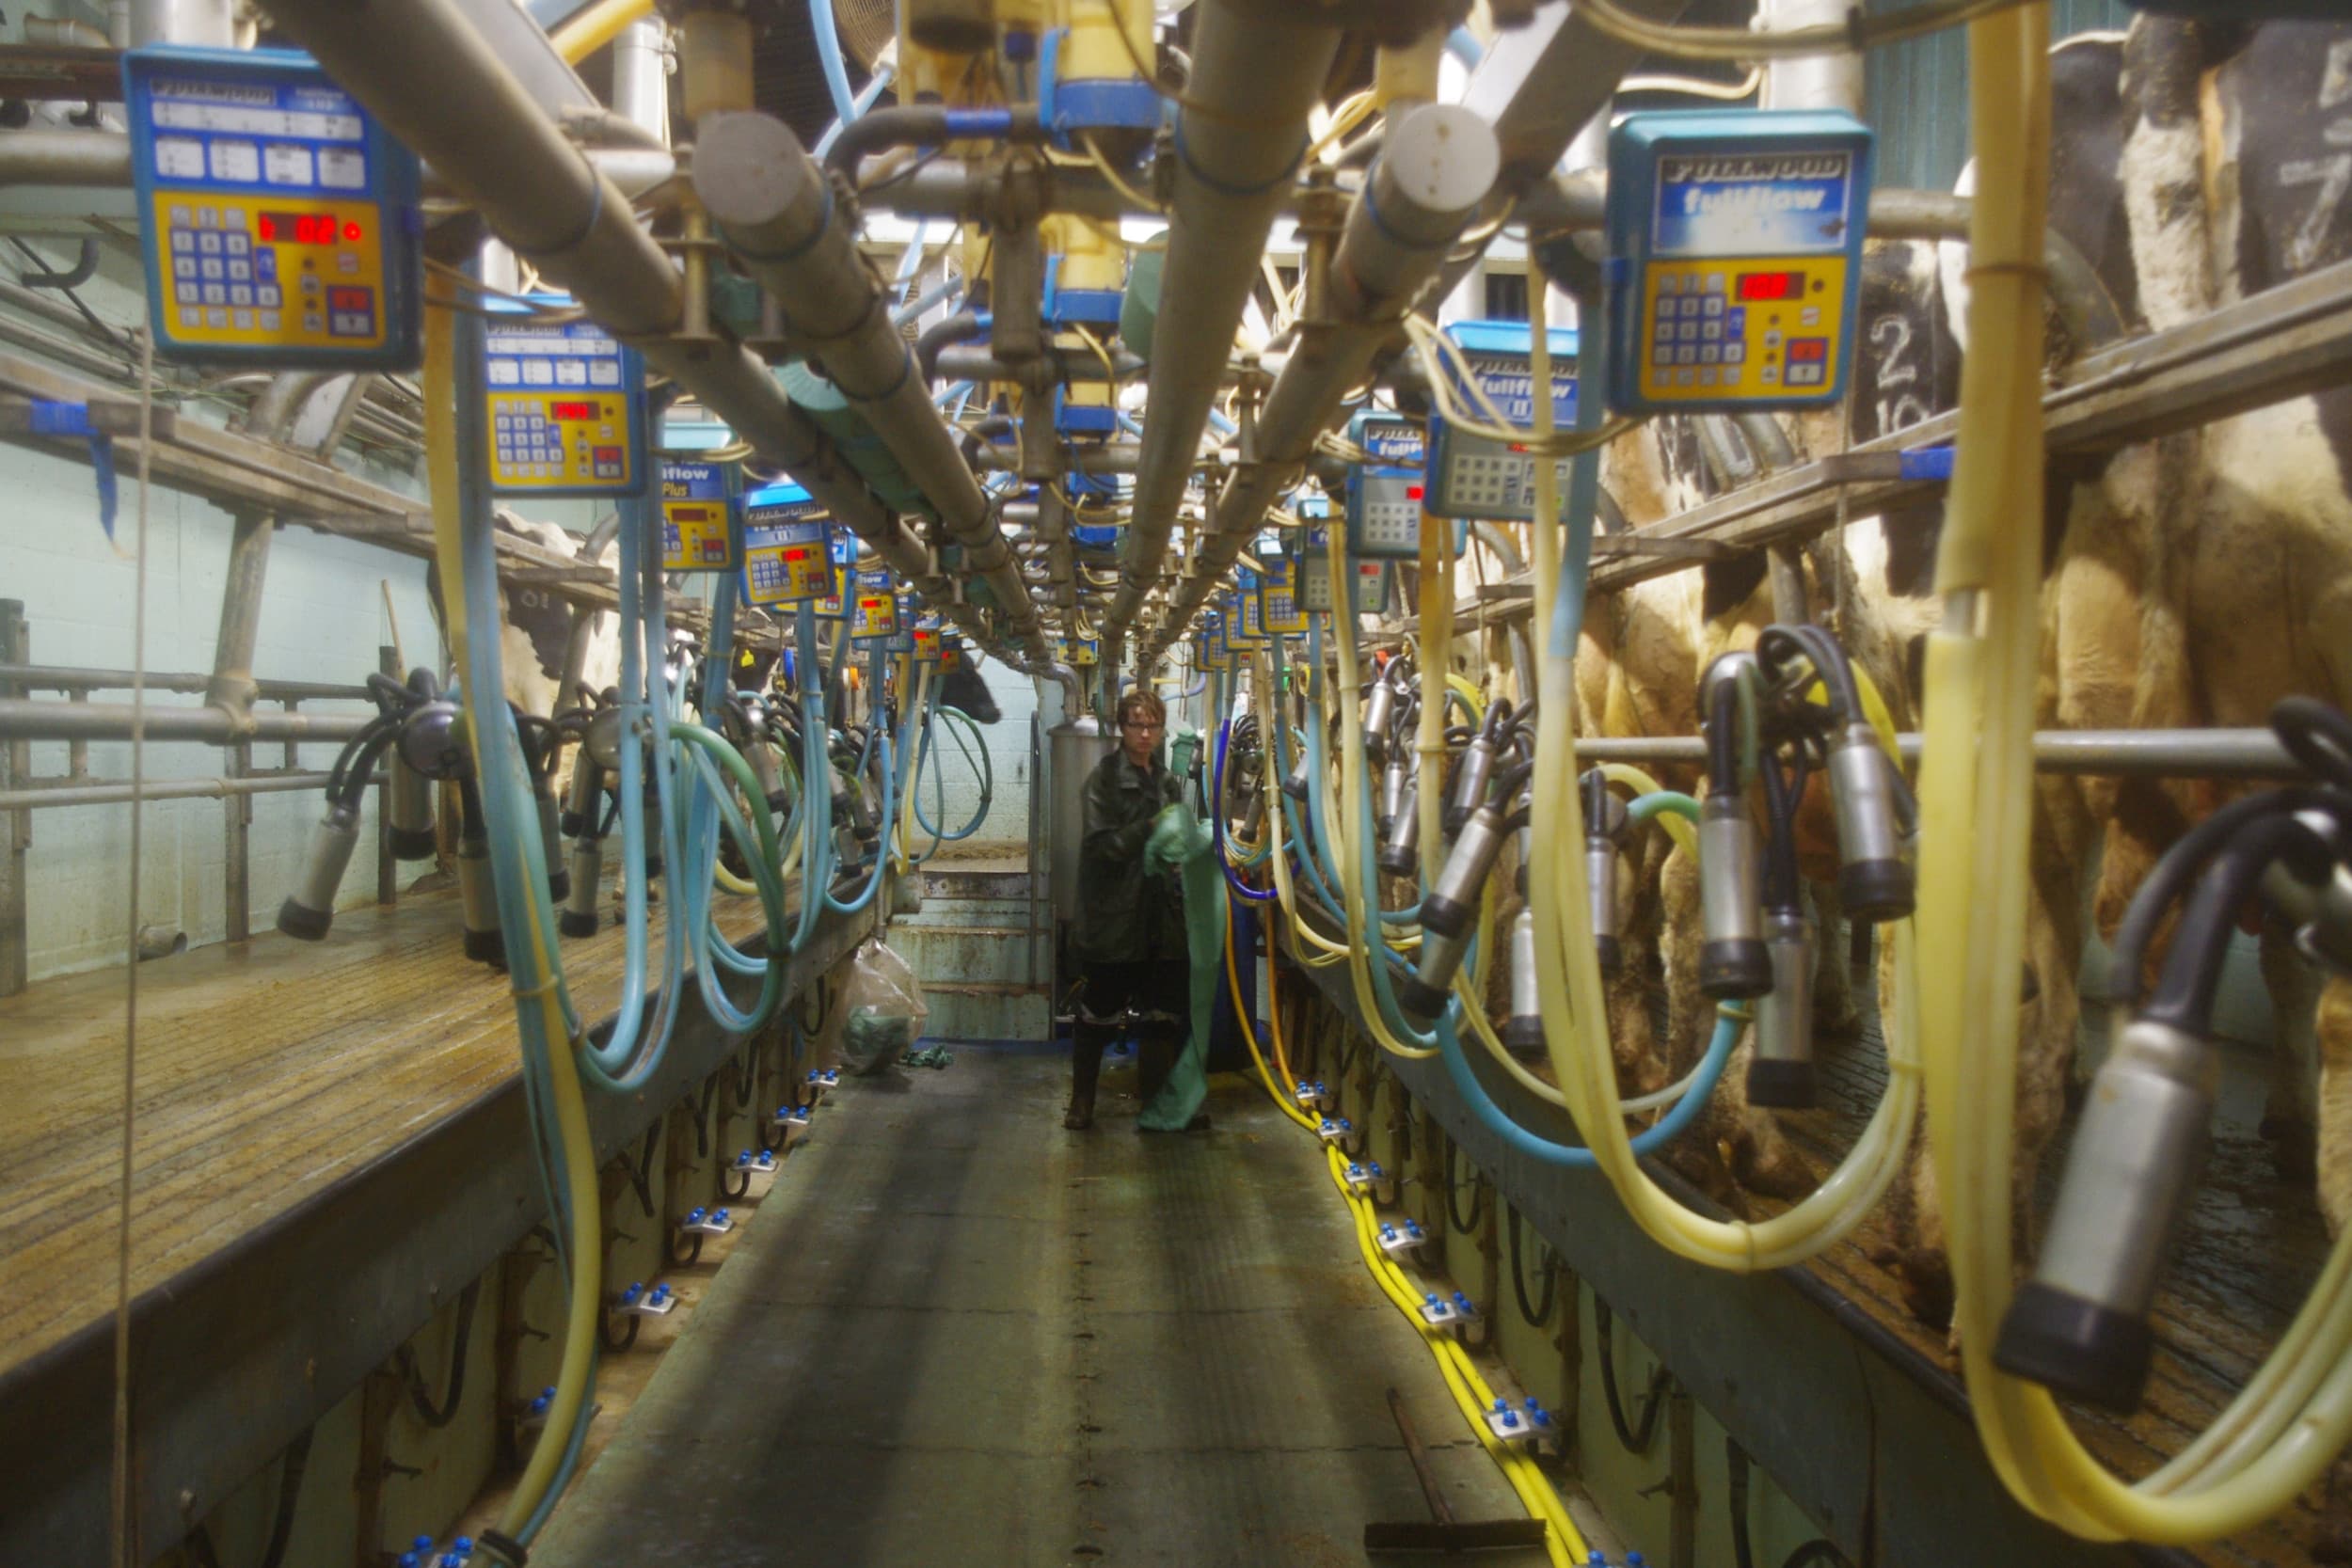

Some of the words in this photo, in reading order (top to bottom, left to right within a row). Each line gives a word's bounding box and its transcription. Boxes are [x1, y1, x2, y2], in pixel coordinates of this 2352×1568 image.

[1684, 185, 1826, 214] fullflow
[1870, 316, 1917, 389] 2
[662, 482, 688, 497] Plus
